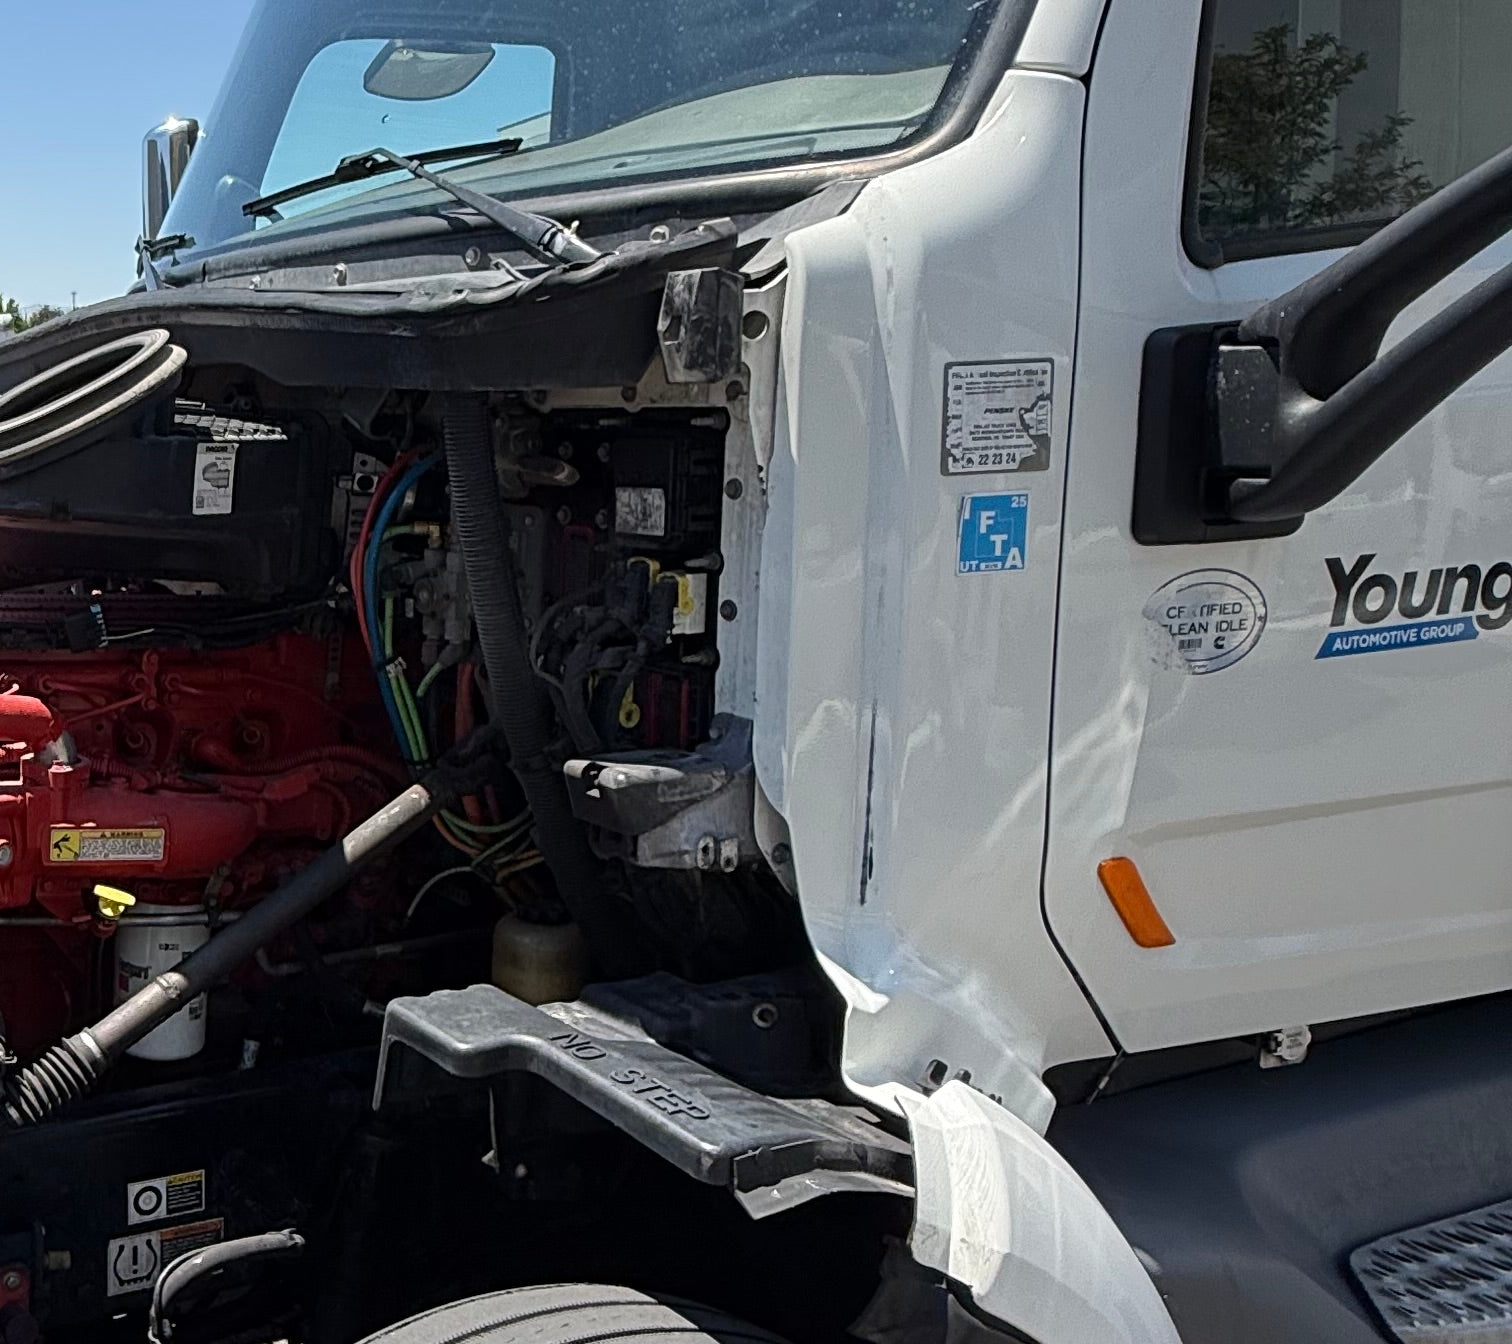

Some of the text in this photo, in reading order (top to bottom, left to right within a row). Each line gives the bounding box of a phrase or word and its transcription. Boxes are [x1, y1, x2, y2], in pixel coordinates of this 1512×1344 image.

[978, 452, 1016, 466] 22 23 24
[1010, 496, 1026, 508] 25
[960, 560, 979, 572] UT
[1324, 553, 1512, 631] Young
[1162, 619, 1248, 636] LEAN IDLE
[1332, 623, 1465, 652] AUTOMOTIVE GROUP
[548, 1033, 711, 1120] NO STEP
